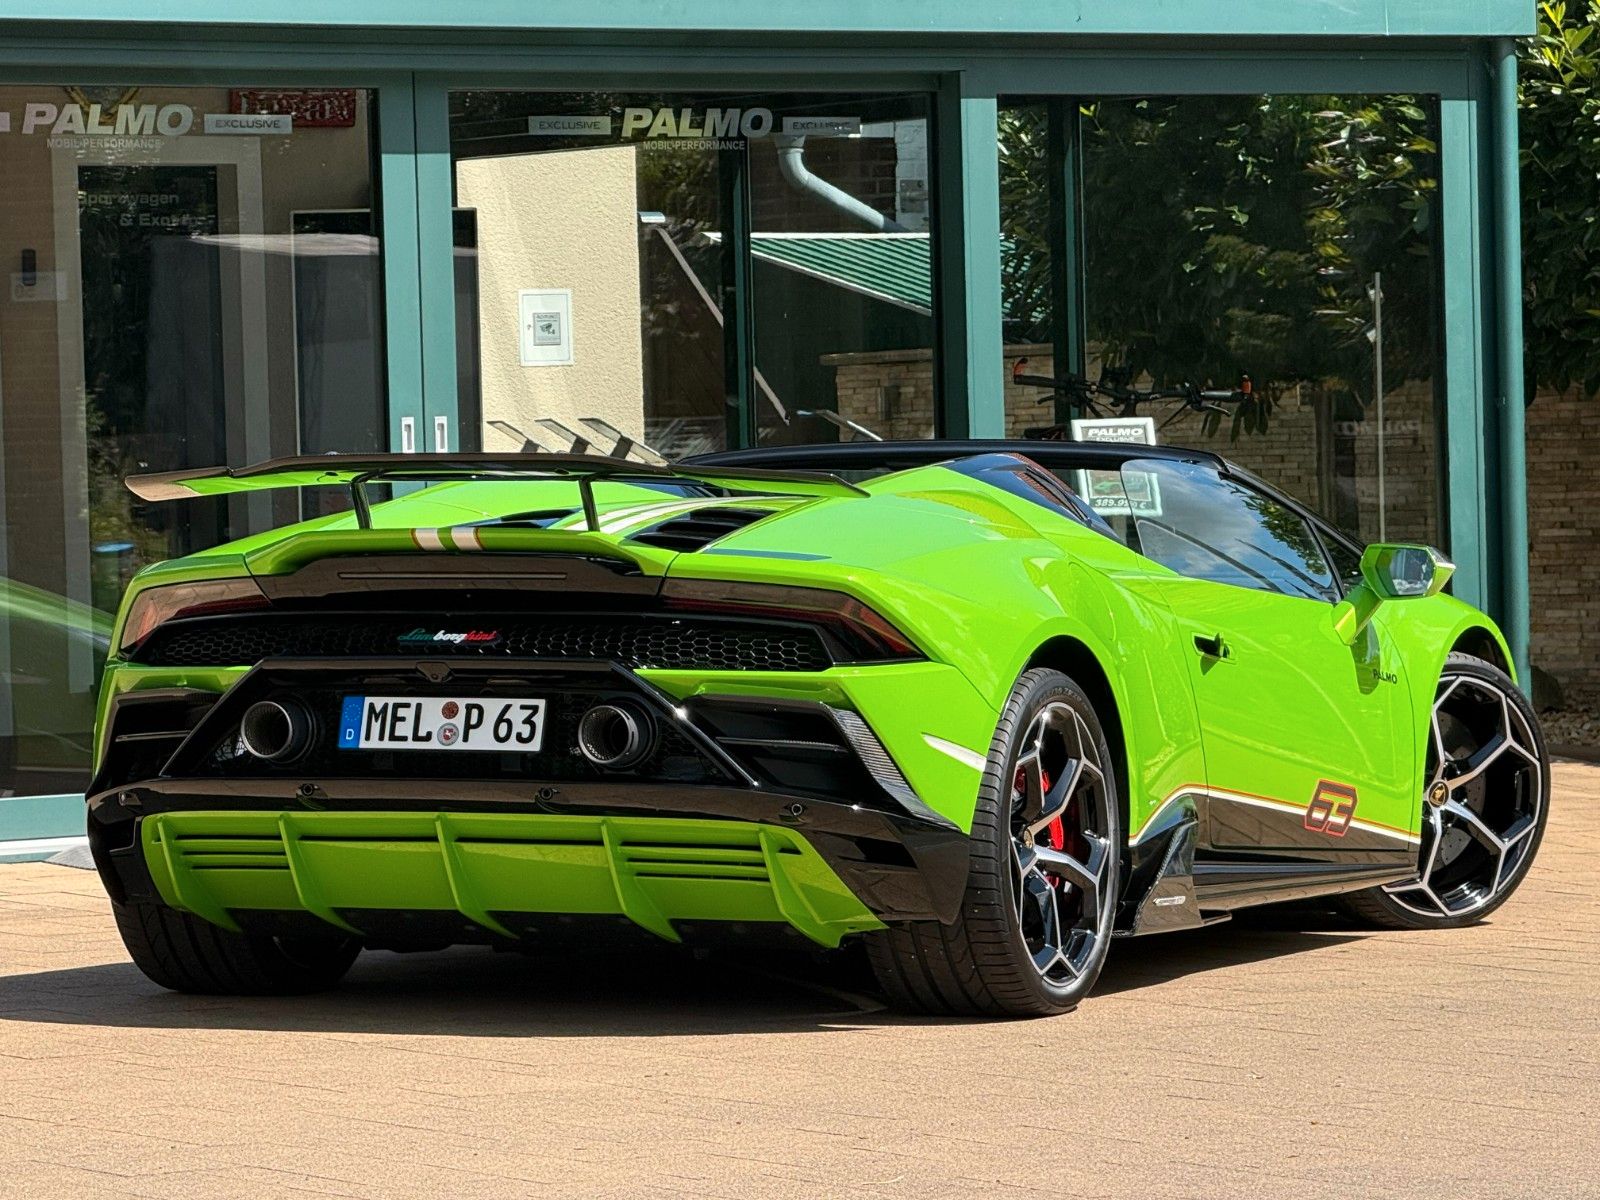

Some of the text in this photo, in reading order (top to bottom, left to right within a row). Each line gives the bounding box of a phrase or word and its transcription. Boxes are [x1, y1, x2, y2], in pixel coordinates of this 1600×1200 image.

[22, 102, 194, 136] PALMO
[214, 118, 282, 129] EXCLUSIVE
[538, 120, 602, 131] EXCLUSIVE
[620, 106, 774, 138] PALMO
[1087, 427, 1144, 437] PALMO
[1372, 668, 1398, 685] PALMO
[364, 701, 540, 744] MEL P 63
[345, 728, 355, 741] D
[1303, 777, 1359, 838] 63
